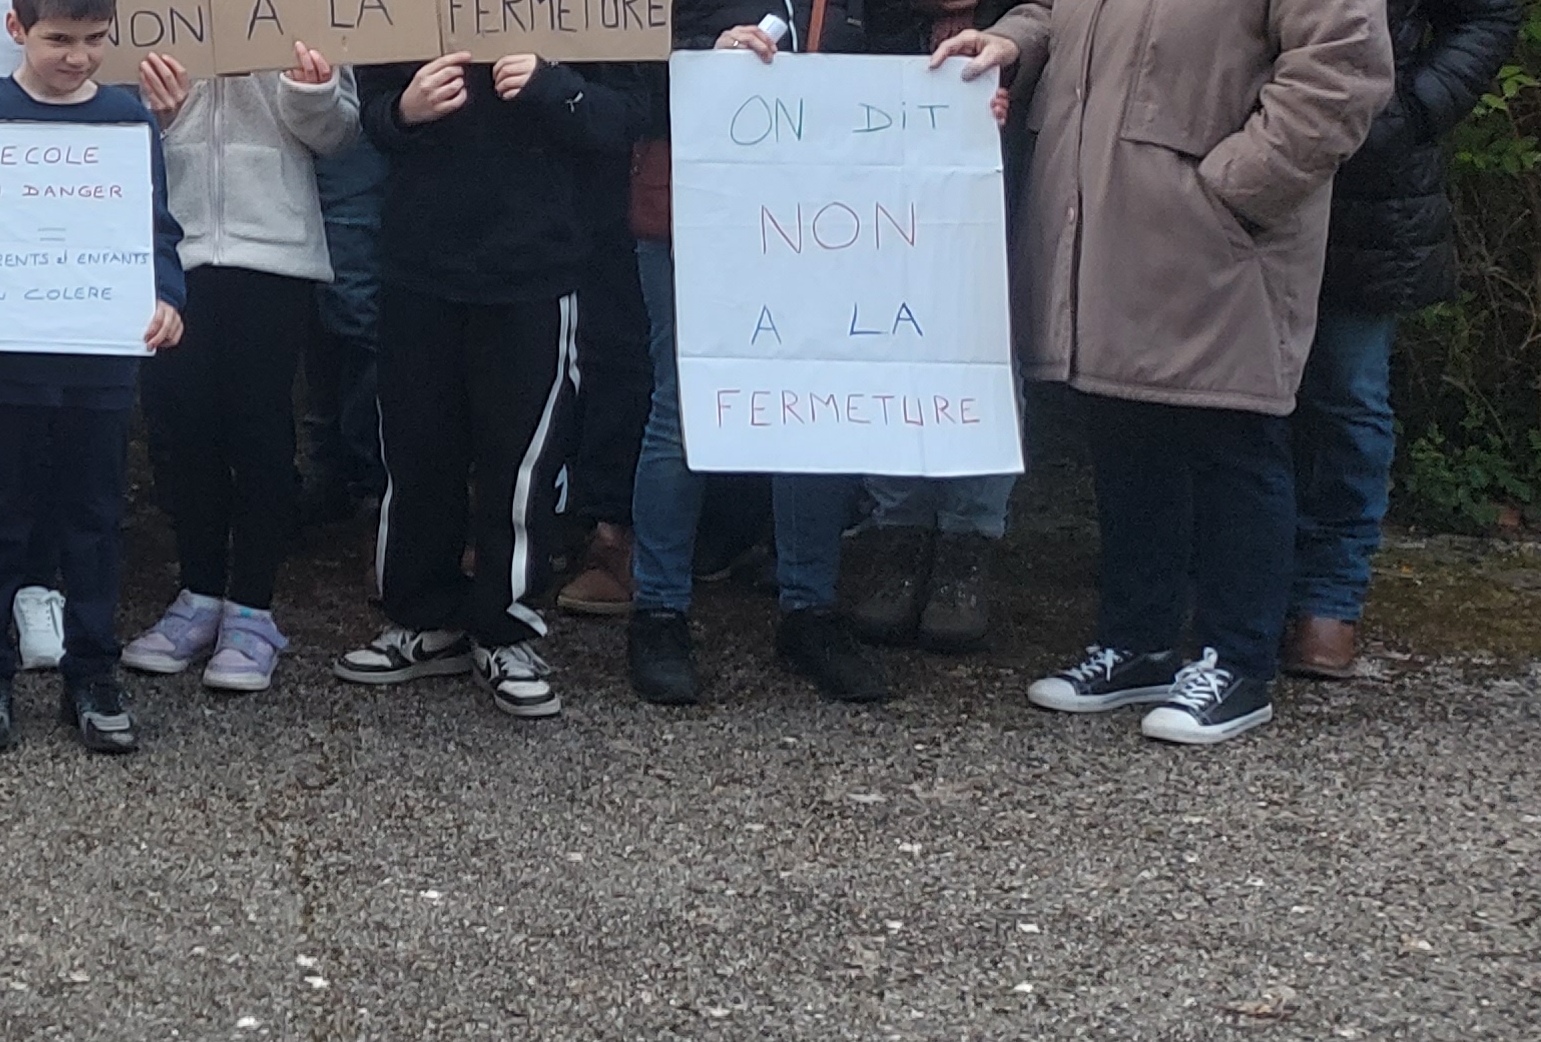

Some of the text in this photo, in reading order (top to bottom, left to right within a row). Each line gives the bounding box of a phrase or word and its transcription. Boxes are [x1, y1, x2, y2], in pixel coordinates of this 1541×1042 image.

[730, 94, 804, 146] ON
[0, 146, 100, 166] ECOLE
[21, 184, 123, 199] DANGER
[761, 201, 916, 254] NON
[24, 286, 113, 301] COLERE
[751, 301, 924, 345] A LA
[716, 389, 982, 428] FERMETURE
